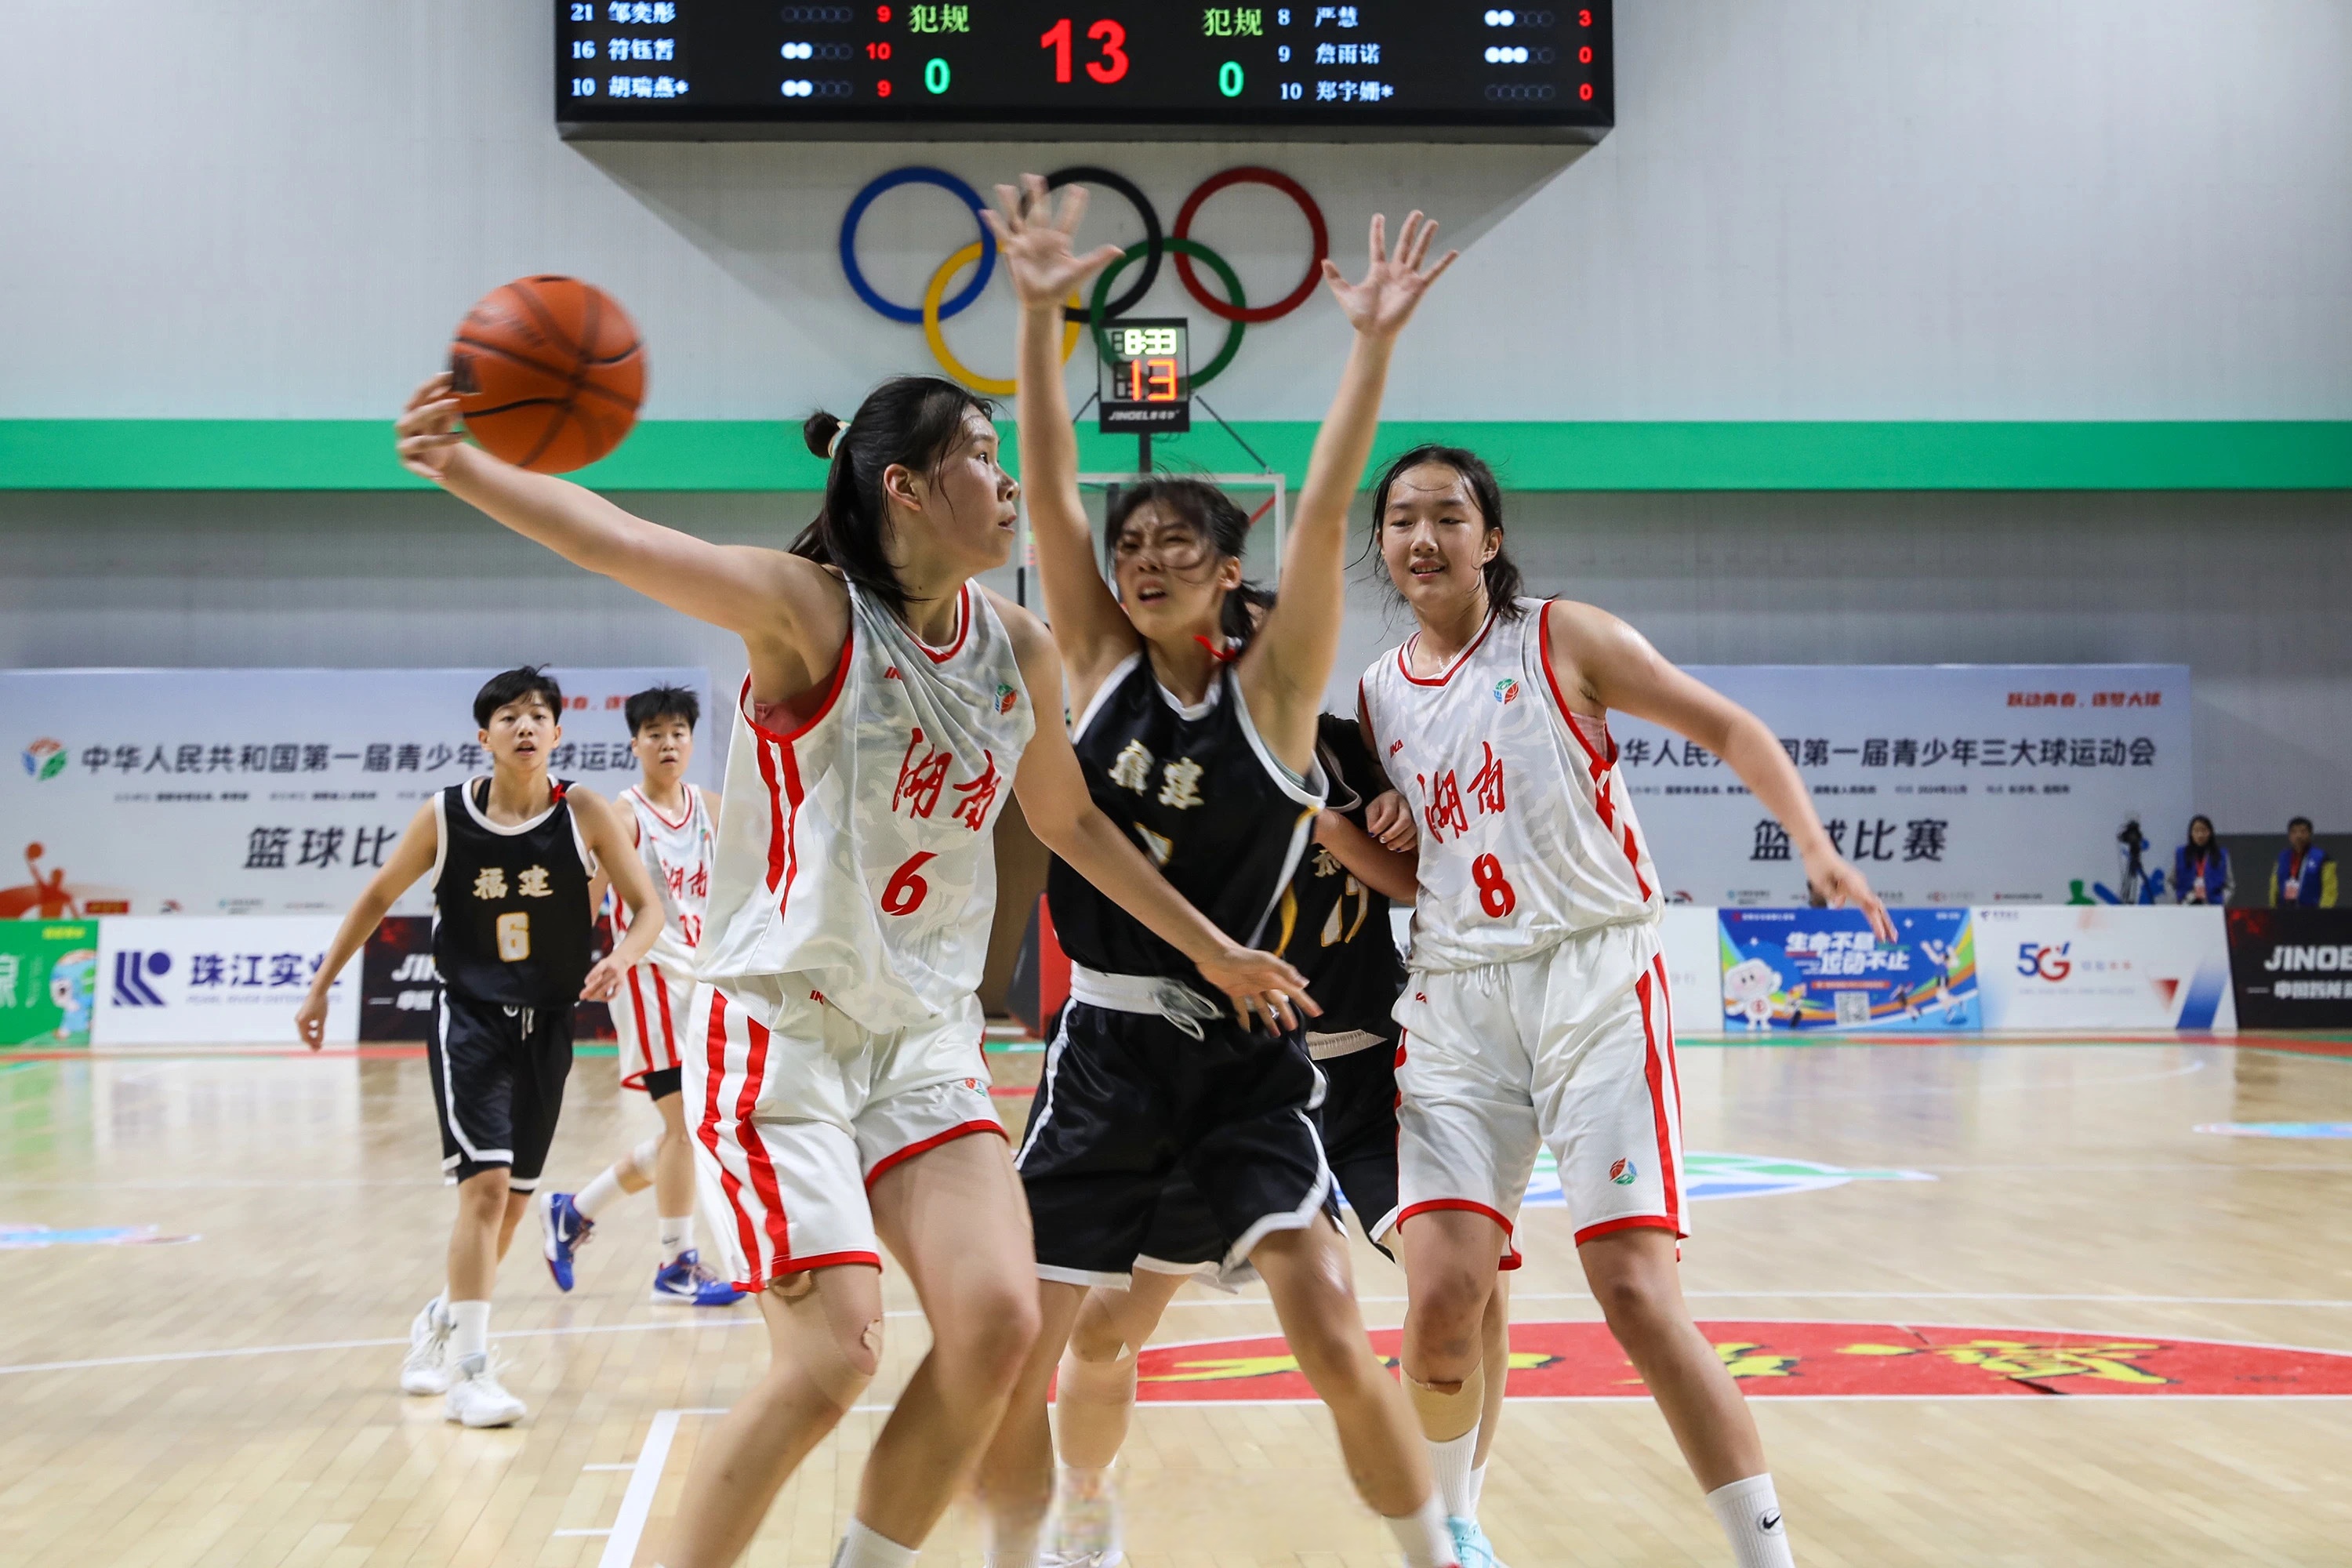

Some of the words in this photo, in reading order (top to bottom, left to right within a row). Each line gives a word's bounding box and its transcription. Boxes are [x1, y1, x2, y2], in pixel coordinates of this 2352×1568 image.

[571, 3, 593, 21] 21
[877, 5, 891, 23] 9
[909, 4, 970, 34] 犯规
[1201, 6, 1264, 36] 犯规
[1277, 8, 1290, 26] 8
[1578, 9, 1592, 27] 3
[572, 40, 597, 60] 16
[866, 42, 891, 60] 10
[1040, 18, 1130, 84] 13
[1277, 45, 1290, 63] 9
[1578, 45, 1592, 64] 0
[572, 77, 597, 96] 10
[877, 79, 891, 98] 9
[924, 57, 951, 95] 0
[1218, 60, 1244, 97] 0
[1280, 82, 1303, 100] 10
[1579, 82, 1593, 101] 0
[1131, 358, 1178, 401] 13
[1416, 741, 1505, 844] 湖南
[243, 826, 398, 869] 篮球比
[472, 866, 554, 899] 福建
[880, 851, 938, 916] 6
[1472, 852, 1515, 918] 8
[496, 912, 530, 962] 6
[2017, 942, 2071, 982] 5G
